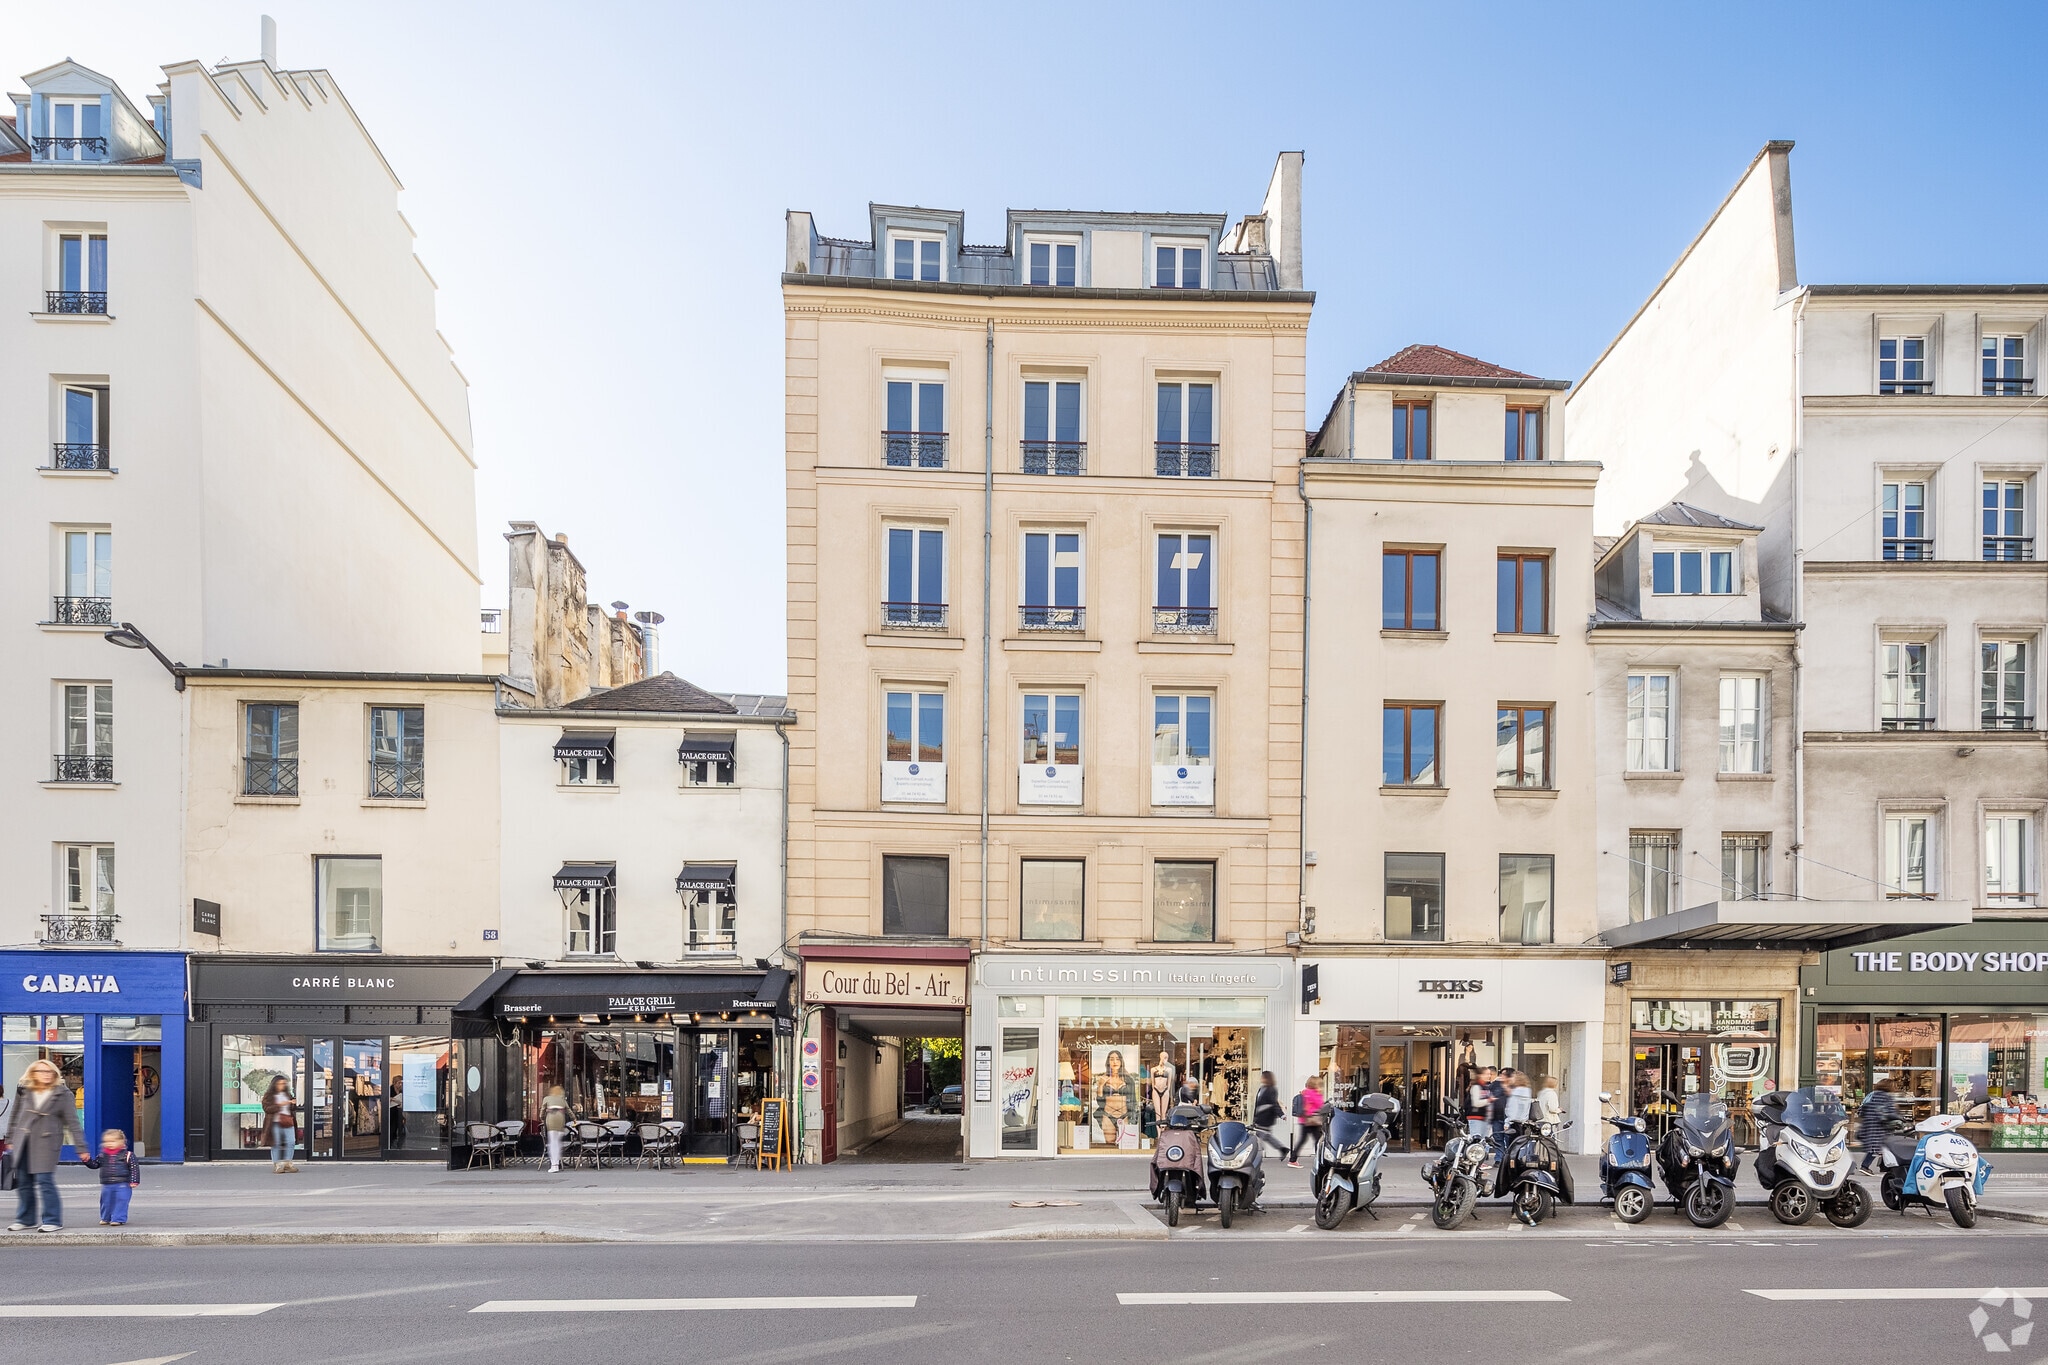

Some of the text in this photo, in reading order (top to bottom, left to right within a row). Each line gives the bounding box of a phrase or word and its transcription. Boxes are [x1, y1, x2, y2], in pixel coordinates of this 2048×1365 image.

[485, 930, 496, 939] 58
[1852, 952, 1902, 972] THE
[1909, 952, 1980, 972] BODY
[1011, 966, 1257, 985] intimissimi Italian lingerie
[292, 976, 395, 988] CARRÉ BLANC
[822, 970, 859, 994] Cour
[862, 971, 881, 995] du
[884, 972, 910, 995] Bel
[924, 973, 950, 997] Air
[1419, 980, 1483, 992] IKKS
[609, 996, 675, 1006] PALACE GRILL
[806, 991, 819, 1000] 56
[950, 996, 964, 1004] 56
[504, 1004, 542, 1012] Brasserie
[1716, 1010, 1756, 1019] FRESH
[1636, 1010, 1712, 1031] LUSH
